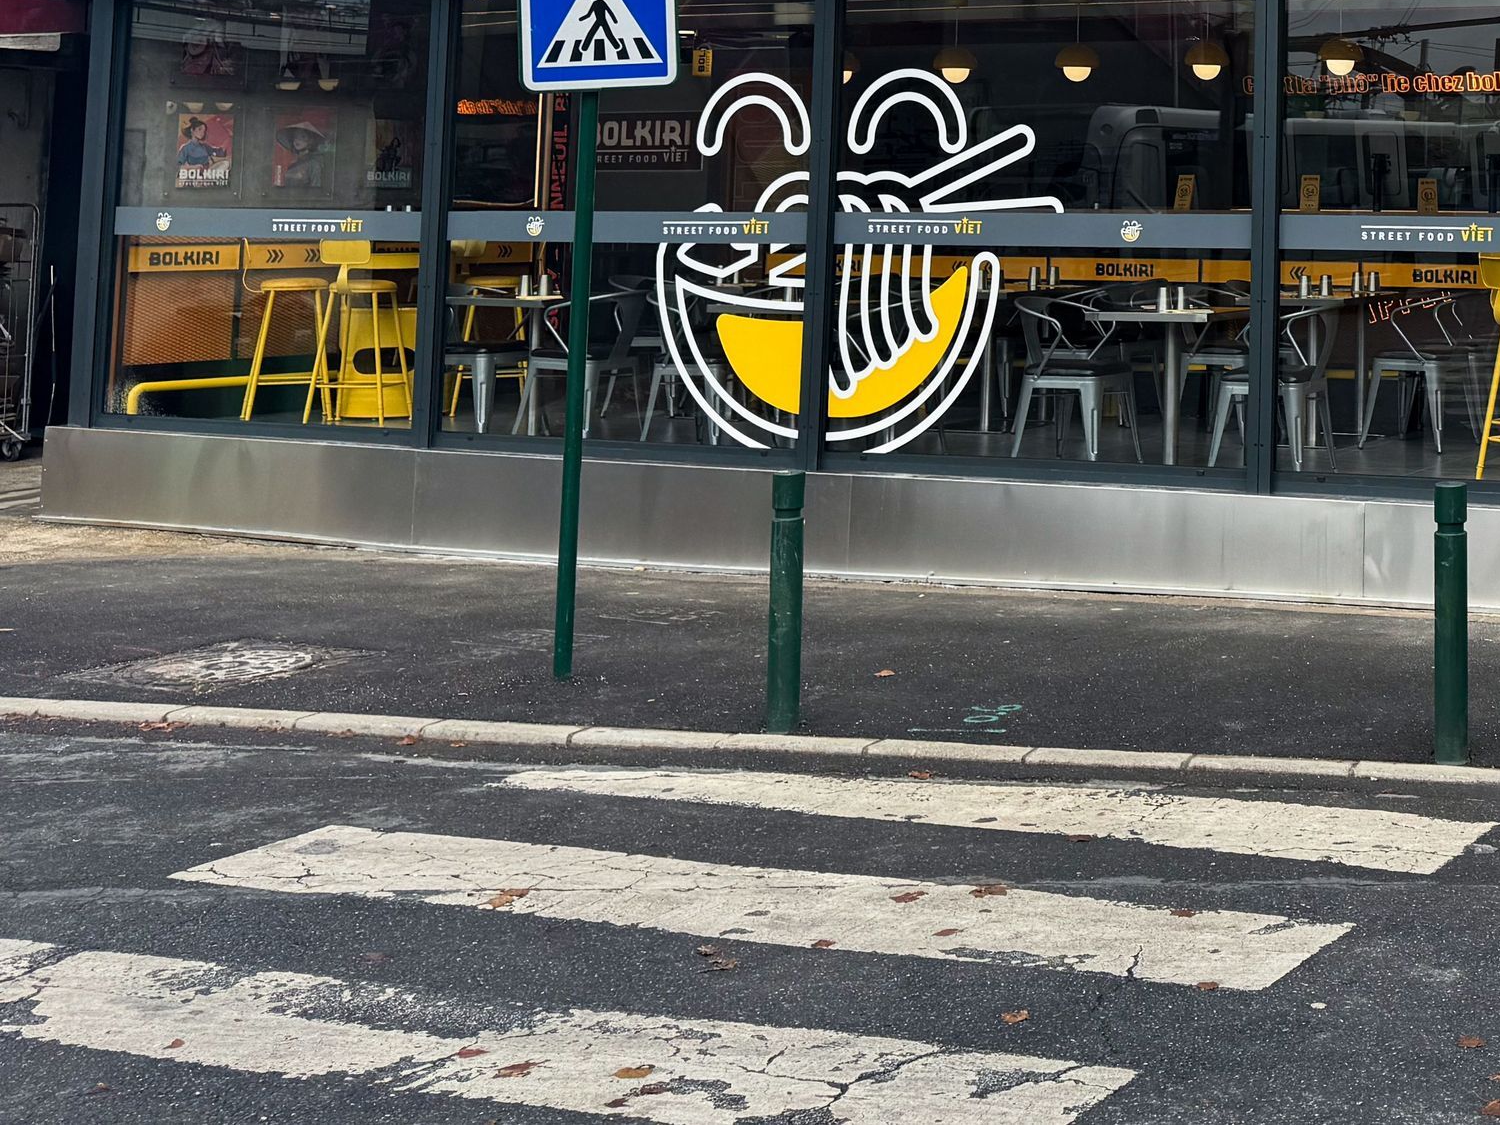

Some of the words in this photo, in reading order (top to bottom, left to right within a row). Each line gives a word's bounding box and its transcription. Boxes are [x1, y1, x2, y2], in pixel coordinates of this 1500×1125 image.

[1413, 73, 1464, 92] chez
[597, 120, 691, 146] OLKIRI
[597, 155, 622, 163] REET
[629, 154, 657, 163] FOOD
[179, 169, 229, 179] BOLKIRI
[272, 224, 307, 232] STREET
[311, 224, 336, 232] FOOD
[663, 226, 703, 235] STREET
[709, 225, 738, 235] FOOD
[742, 221, 769, 234] VIET
[868, 224, 911, 234] STREET
[918, 225, 948, 234] FOOD
[954, 221, 982, 234] VIET
[1361, 231, 1412, 242] STREET
[1418, 231, 1454, 242] FOOD
[1461, 227, 1493, 242] VIET
[149, 250, 220, 266] BOLKIRI
[1095, 262, 1154, 278] BOLKIRI
[1412, 268, 1478, 285] BOLKIRI
